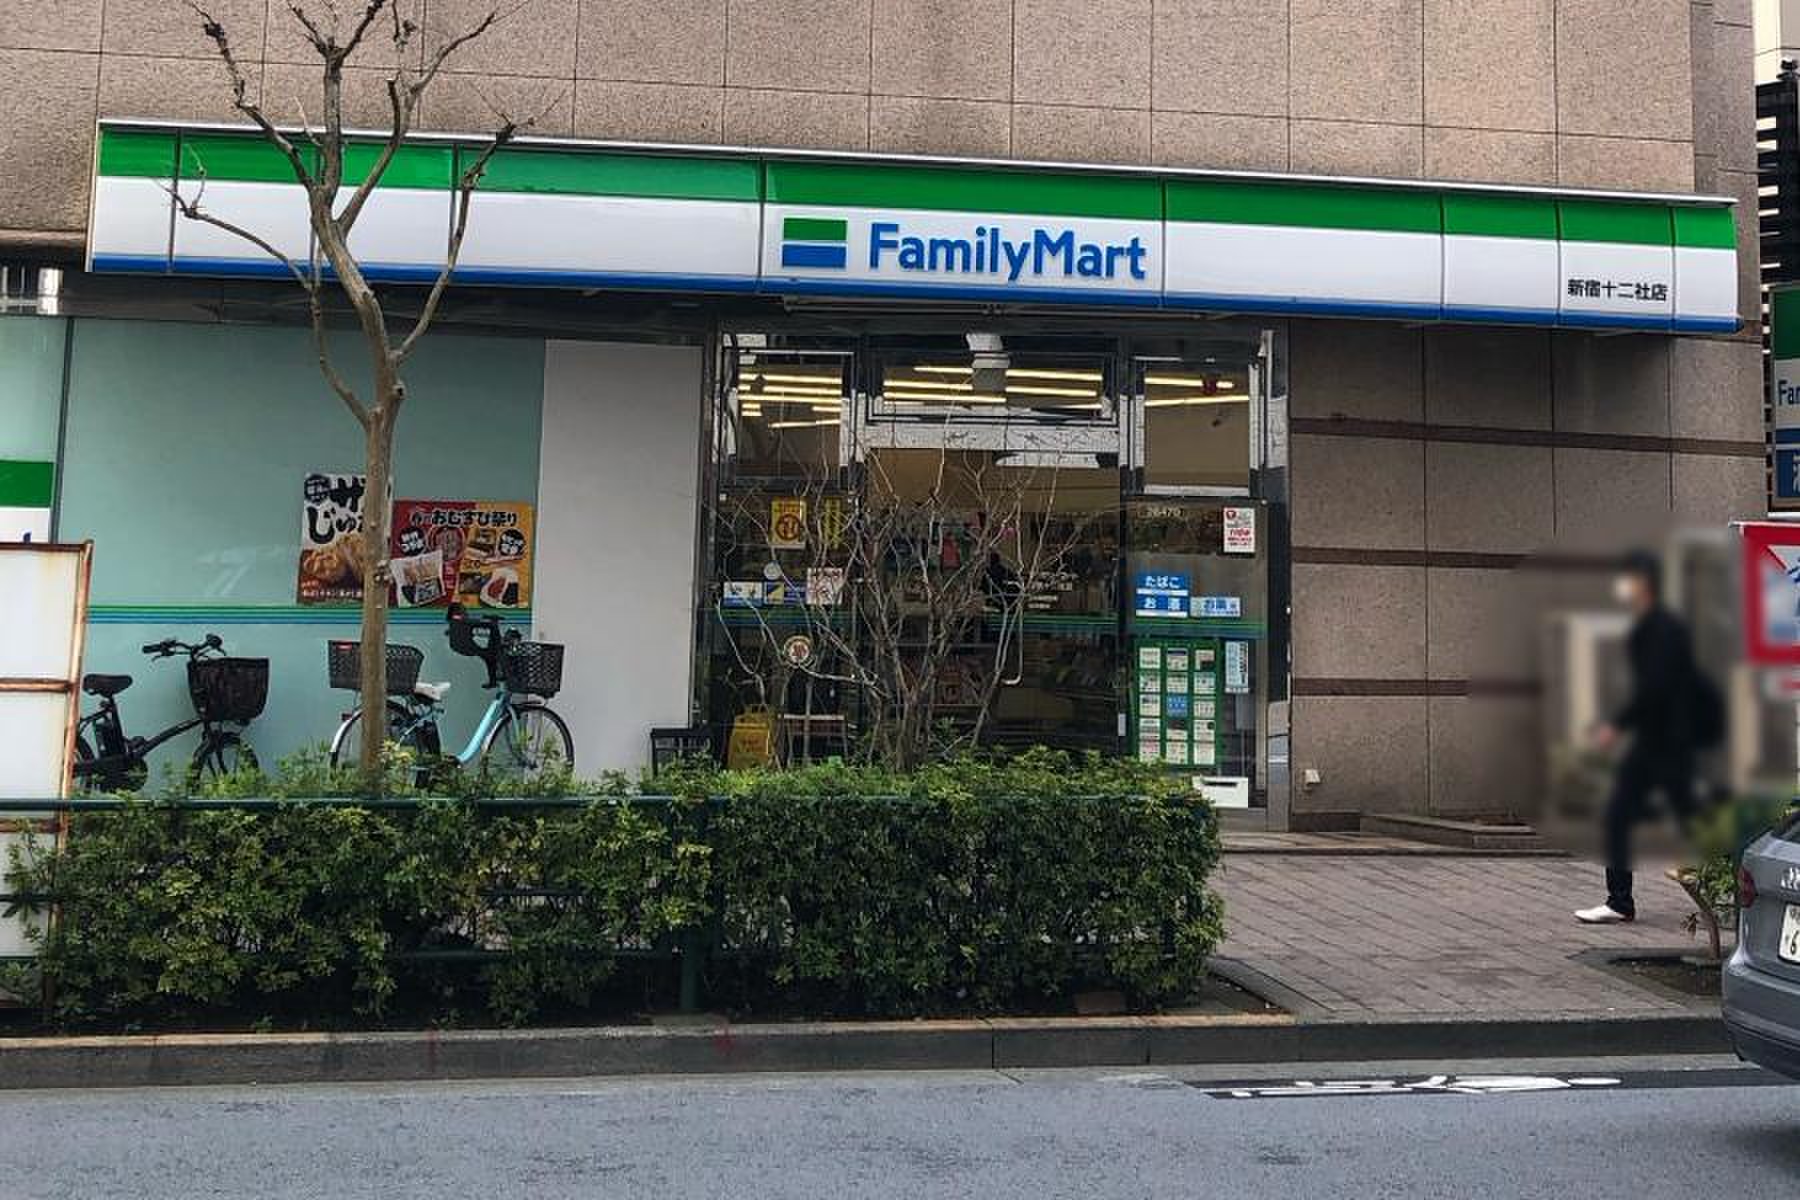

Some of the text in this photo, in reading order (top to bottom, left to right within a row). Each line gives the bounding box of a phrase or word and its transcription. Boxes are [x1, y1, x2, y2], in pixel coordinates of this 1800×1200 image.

[869, 222, 1146, 281] FamilyMart
[1567, 278, 1669, 302] 新宿十二社店
[1778, 379, 1800, 406] Fa
[1144, 575, 1181, 589] たばこ
